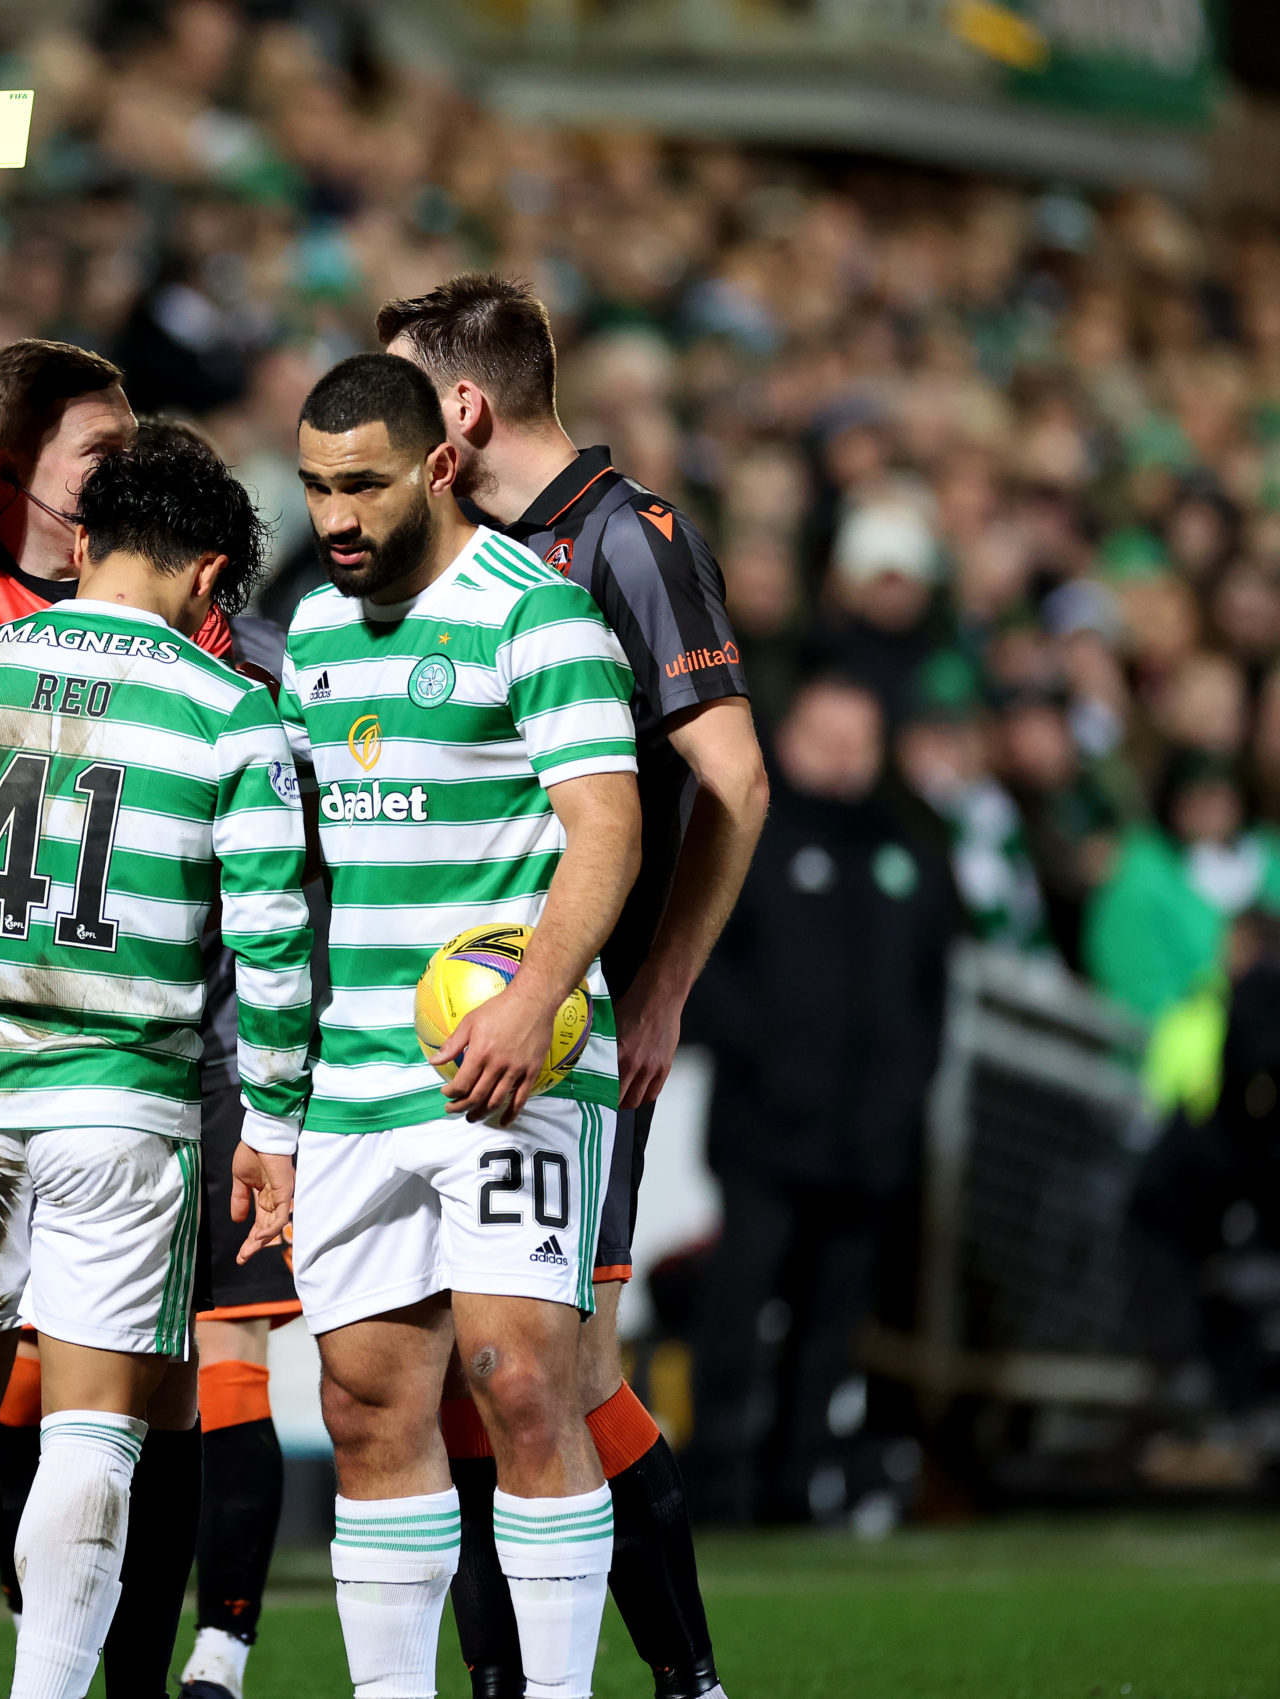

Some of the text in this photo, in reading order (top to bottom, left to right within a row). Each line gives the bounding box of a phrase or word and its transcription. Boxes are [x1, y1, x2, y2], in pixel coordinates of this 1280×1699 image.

[665, 648, 726, 678] utilita
[30, 672, 112, 718] REO
[310, 689, 332, 701] adidas
[284, 776, 300, 791] cin
[9, 920, 25, 929] SPFL
[82, 930, 97, 939] SPFL
[477, 1147, 570, 1232] 20
[529, 1252, 569, 1267] adidas
